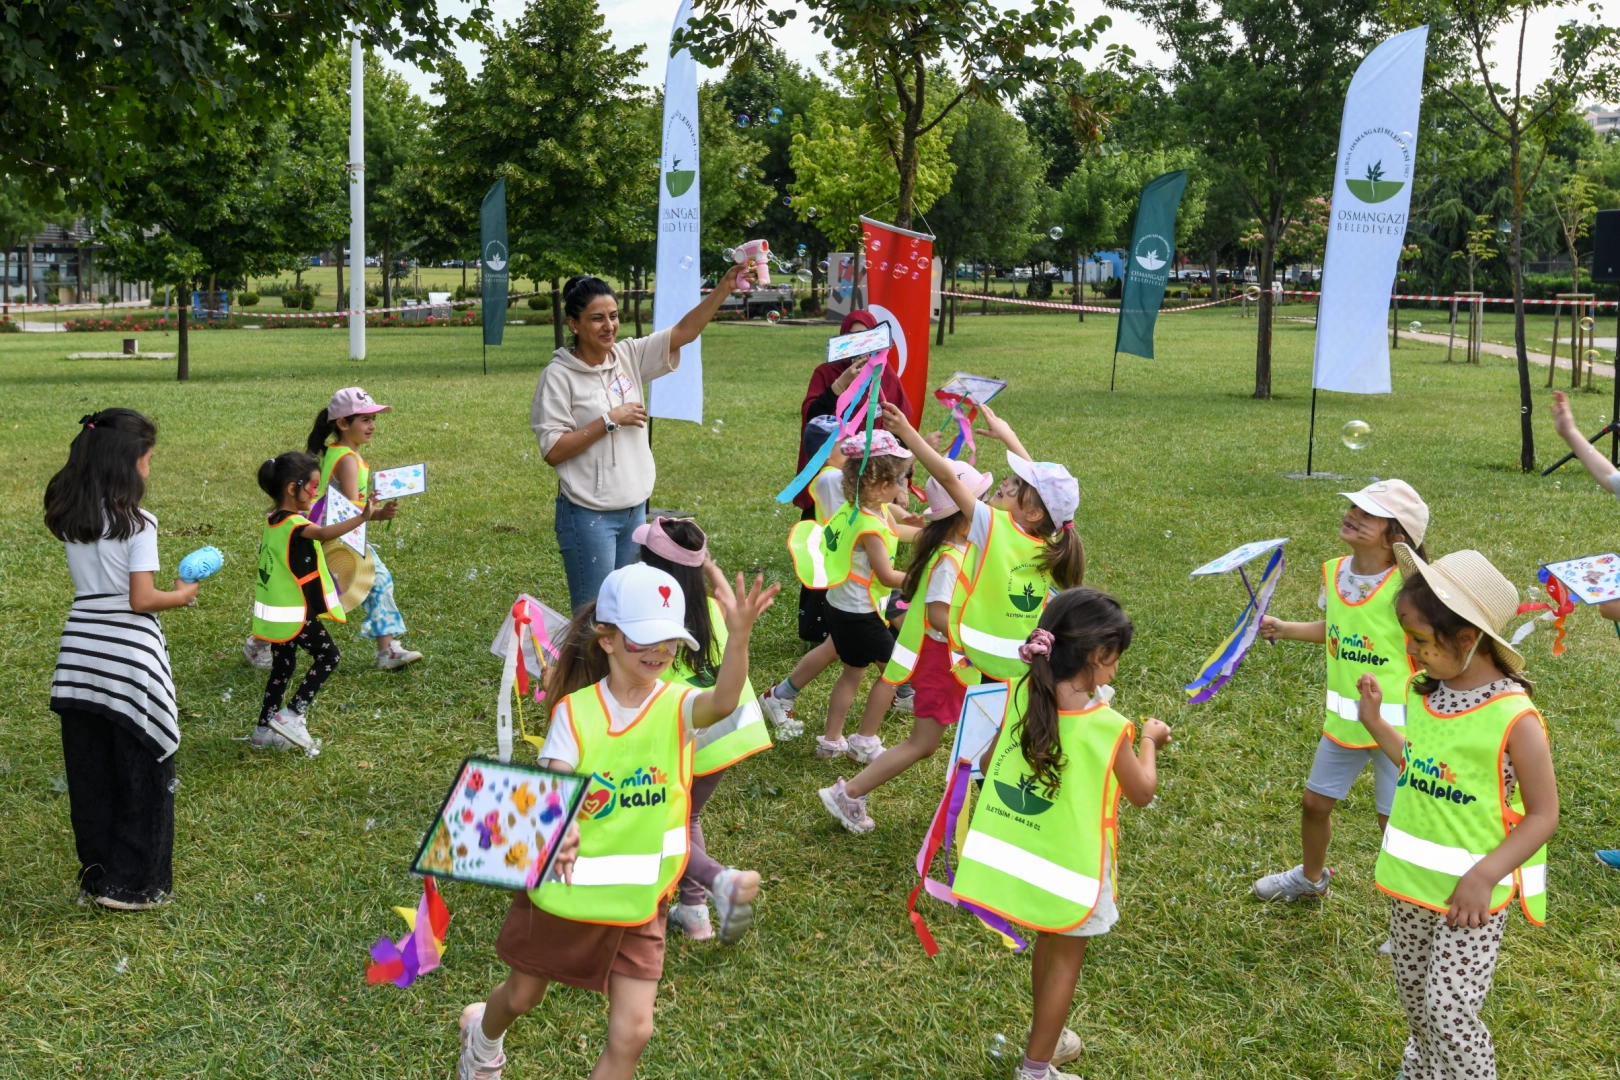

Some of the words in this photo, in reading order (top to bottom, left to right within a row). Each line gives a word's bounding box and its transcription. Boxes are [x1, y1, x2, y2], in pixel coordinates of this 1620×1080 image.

[1344, 152, 1352, 175] BURSA
[1349, 127, 1384, 151] OSMANGAZİ
[1338, 210, 1406, 225] OSMANGAZİ
[1337, 222, 1404, 236] BELEDİYESİ
[1342, 633, 1375, 652] minik
[1341, 648, 1389, 666] kalpler
[994, 754, 1006, 776] BURSA
[1412, 757, 1457, 784] minik
[620, 766, 668, 789] minik
[1409, 772, 1477, 805] kalpler
[1014, 816, 1025, 824] 444
